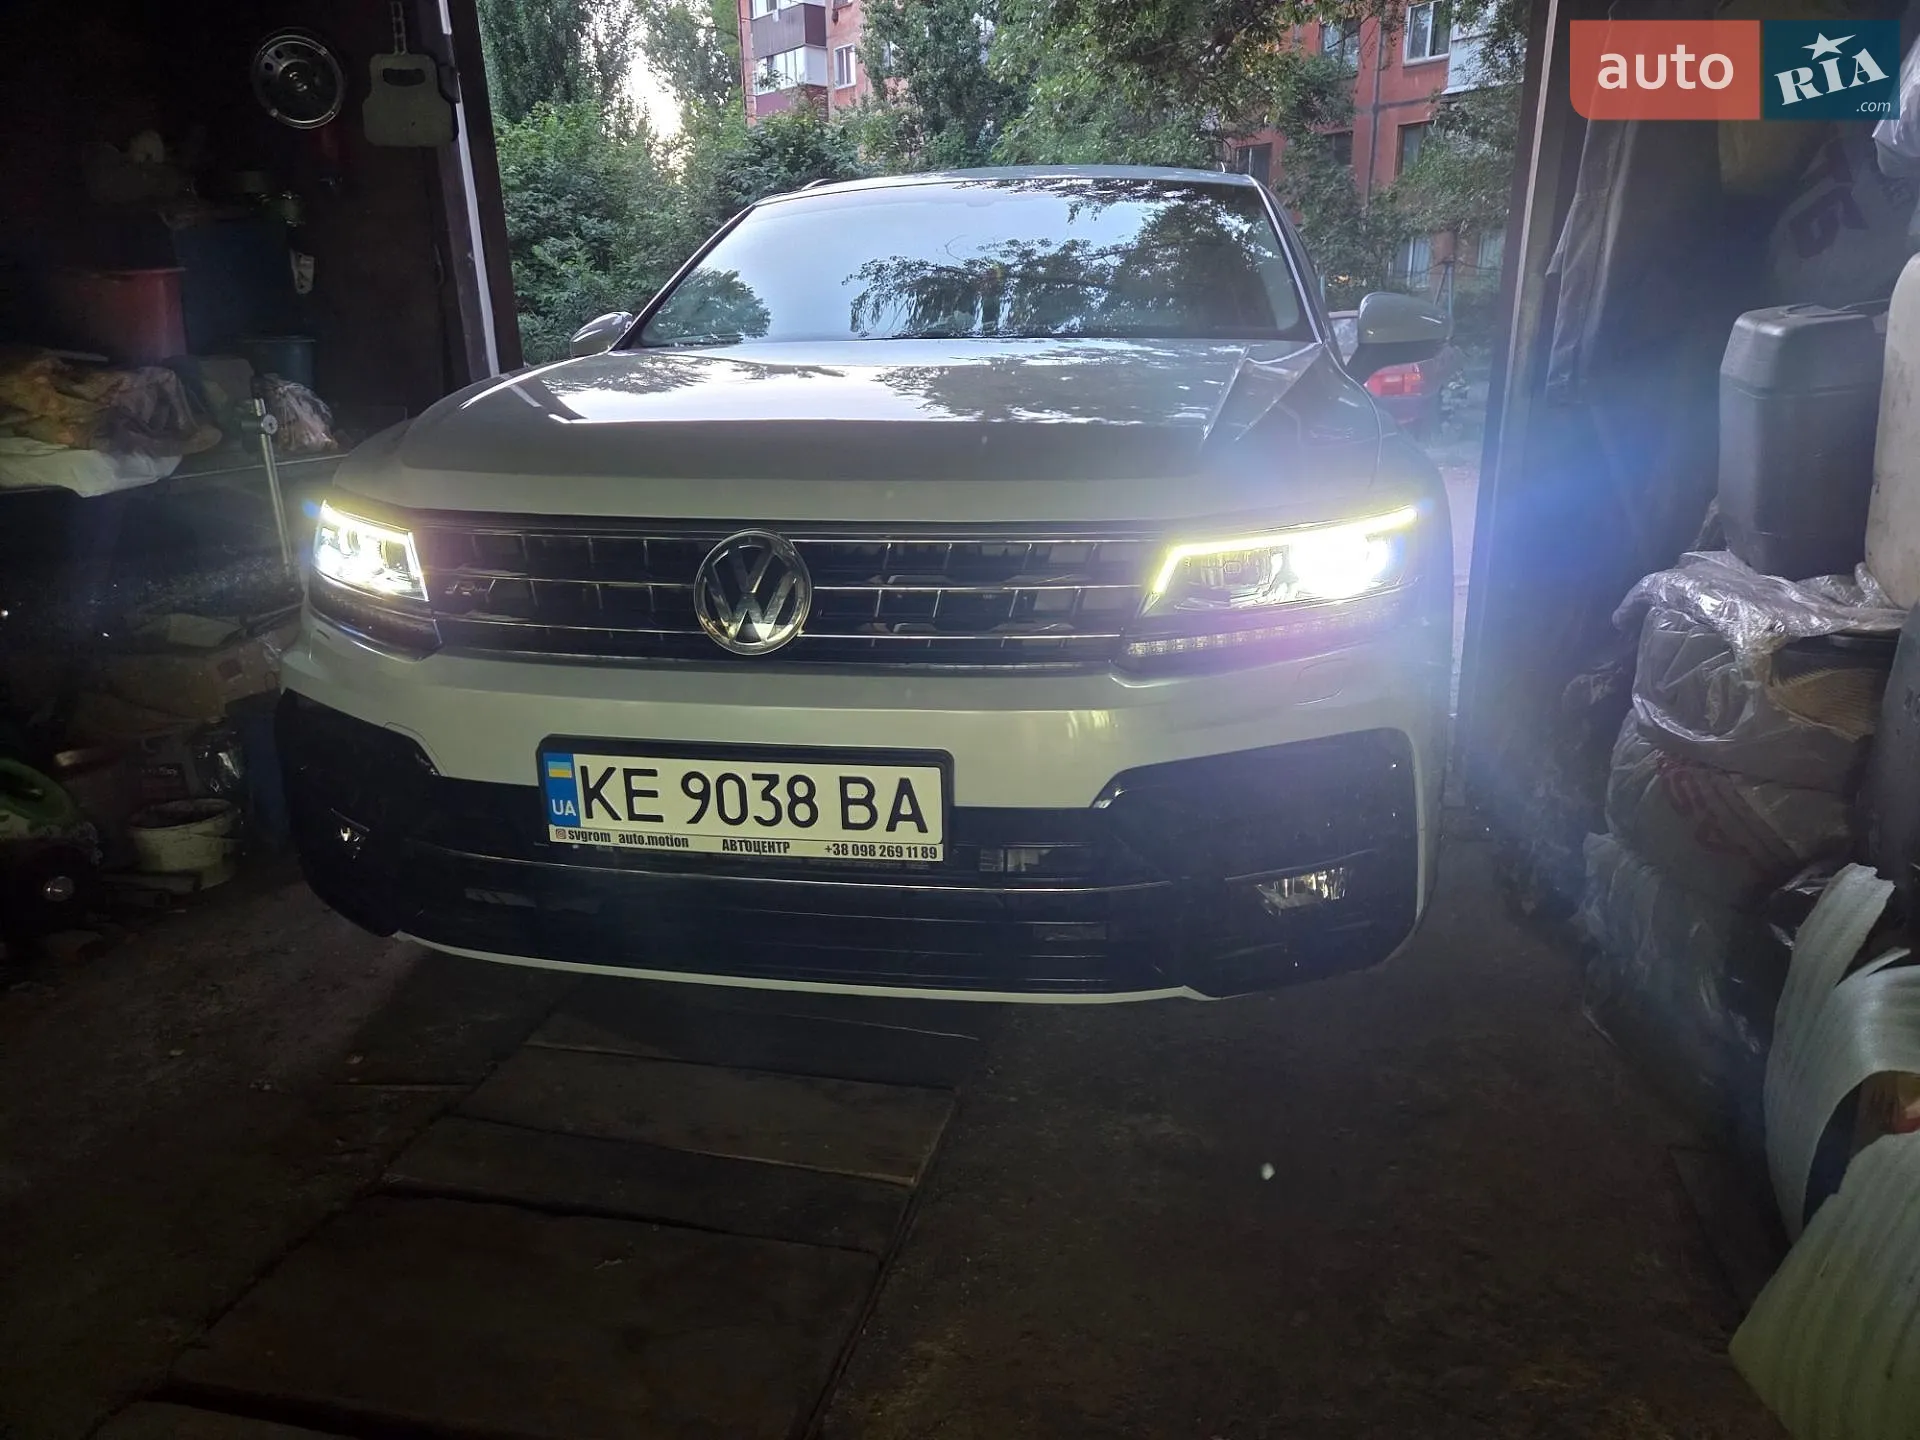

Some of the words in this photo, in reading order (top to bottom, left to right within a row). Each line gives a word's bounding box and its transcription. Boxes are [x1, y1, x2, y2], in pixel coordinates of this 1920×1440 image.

[551, 799, 577, 817] UA
[580, 765, 664, 823] KE
[680, 771, 819, 829] 9038
[839, 776, 929, 834] BA
[722, 839, 791, 855] АВТОЦЕНТР
[825, 844, 850, 856] +38
[851, 844, 877, 858] 098
[879, 845, 905, 859] 269
[906, 846, 919, 859] 11
[920, 847, 938, 860] 89
